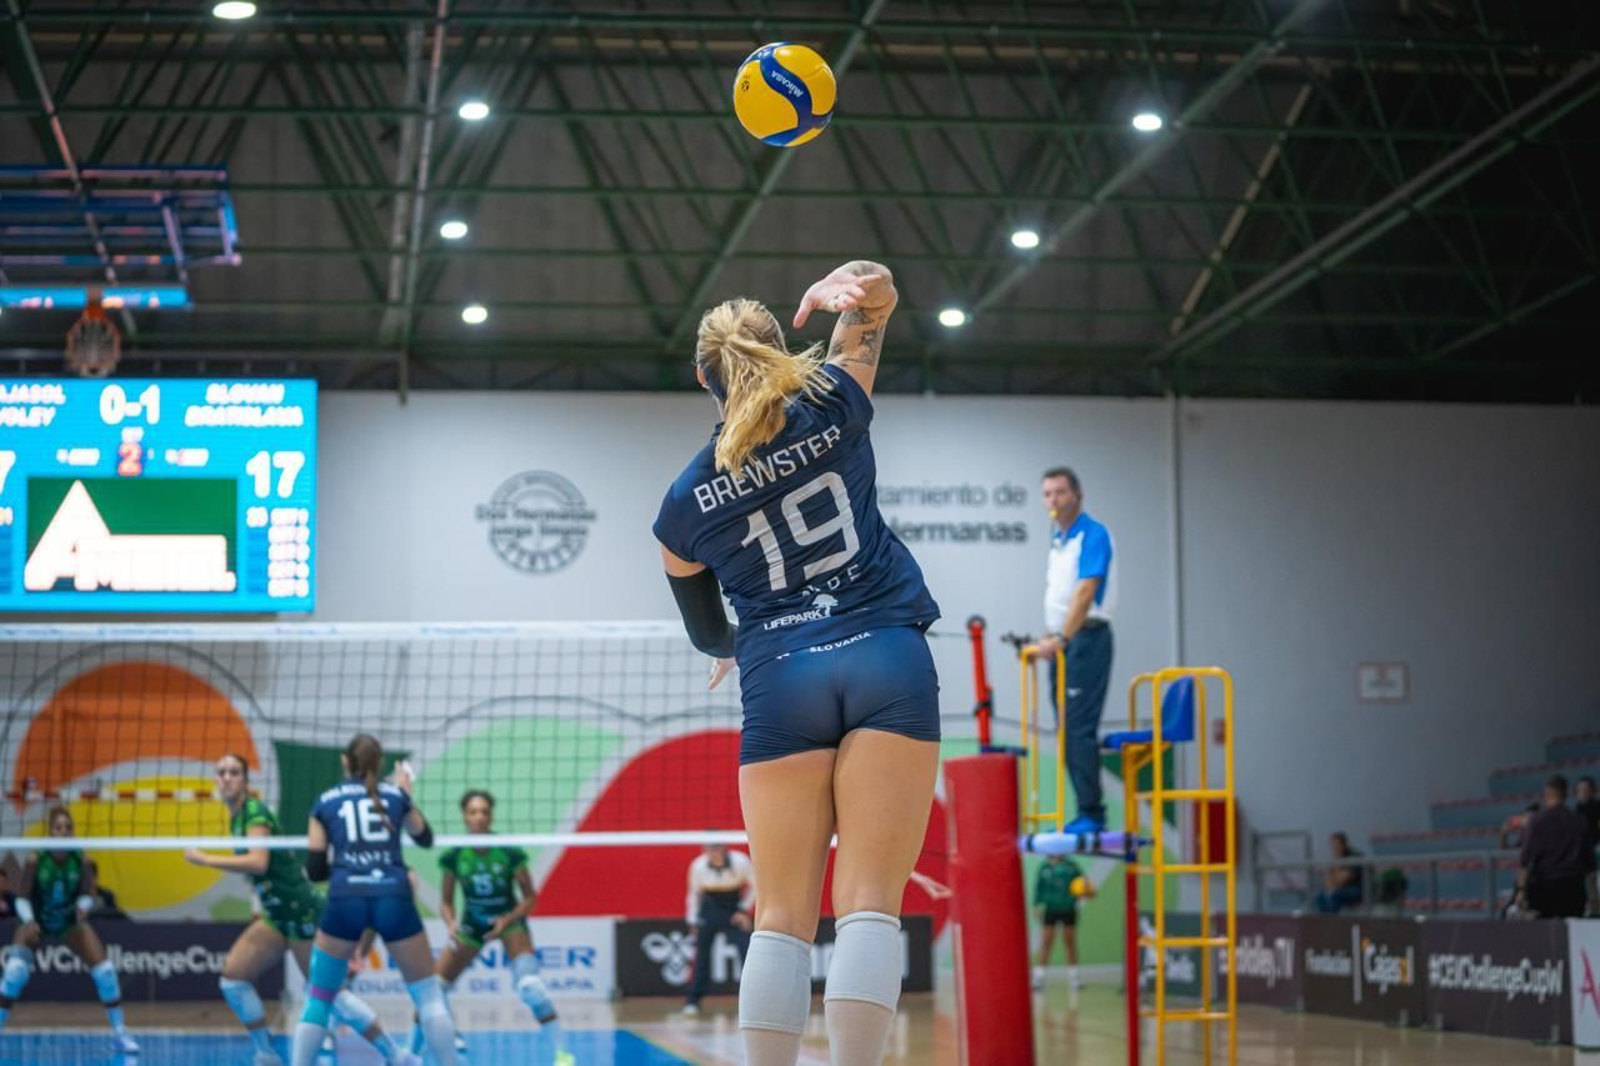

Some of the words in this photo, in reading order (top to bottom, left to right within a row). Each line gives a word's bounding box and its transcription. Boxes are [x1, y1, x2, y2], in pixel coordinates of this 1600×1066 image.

[246, 450, 305, 498] 17
[694, 425, 841, 513] BREWSTER
[741, 471, 860, 591] 19
[764, 608, 823, 631] LIFEPARK
